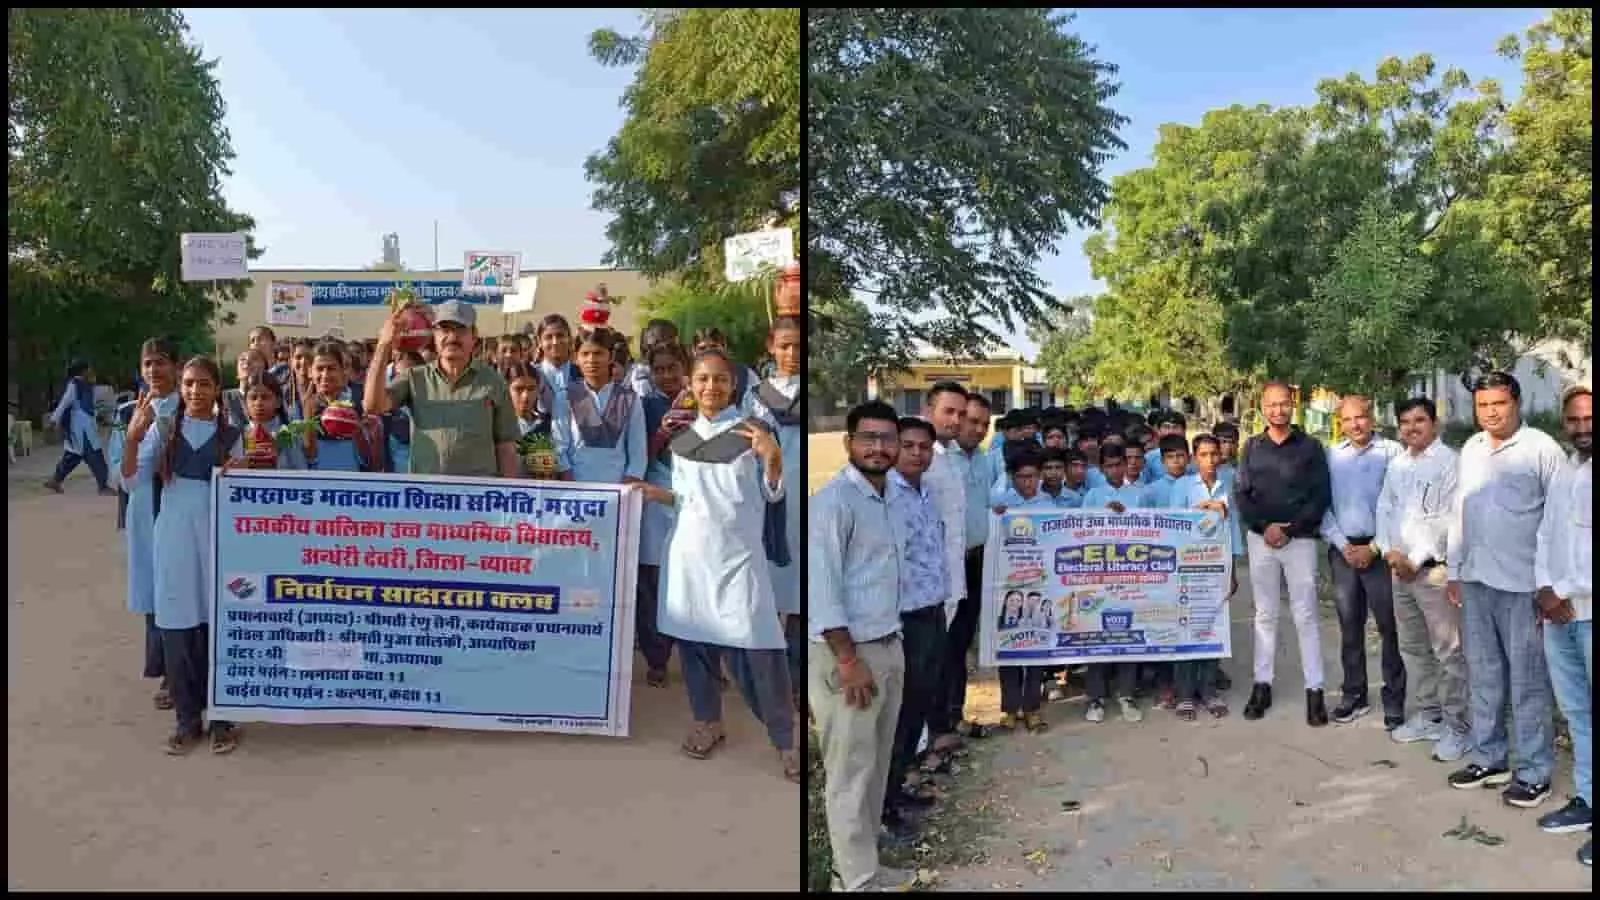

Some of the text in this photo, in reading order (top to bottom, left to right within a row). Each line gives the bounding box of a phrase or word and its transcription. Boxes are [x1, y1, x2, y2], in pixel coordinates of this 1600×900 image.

[229, 485, 315, 506] उपखण्ड
[319, 488, 400, 508] मतदाता
[405, 488, 461, 512] शिक्षा
[233, 513, 310, 536] राजकीय
[390, 521, 421, 541] उच्च
[426, 520, 512, 543] माध्यमिक
[1083, 544, 1149, 562] ELC
[1057, 560, 1104, 572] Electoral
[1107, 561, 1148, 573] Literacy
[1151, 560, 1174, 571] Club
[274, 577, 376, 602] निर्वाचन
[381, 585, 485, 608] साक्षरता
[1105, 615, 1128, 625] VOTE
